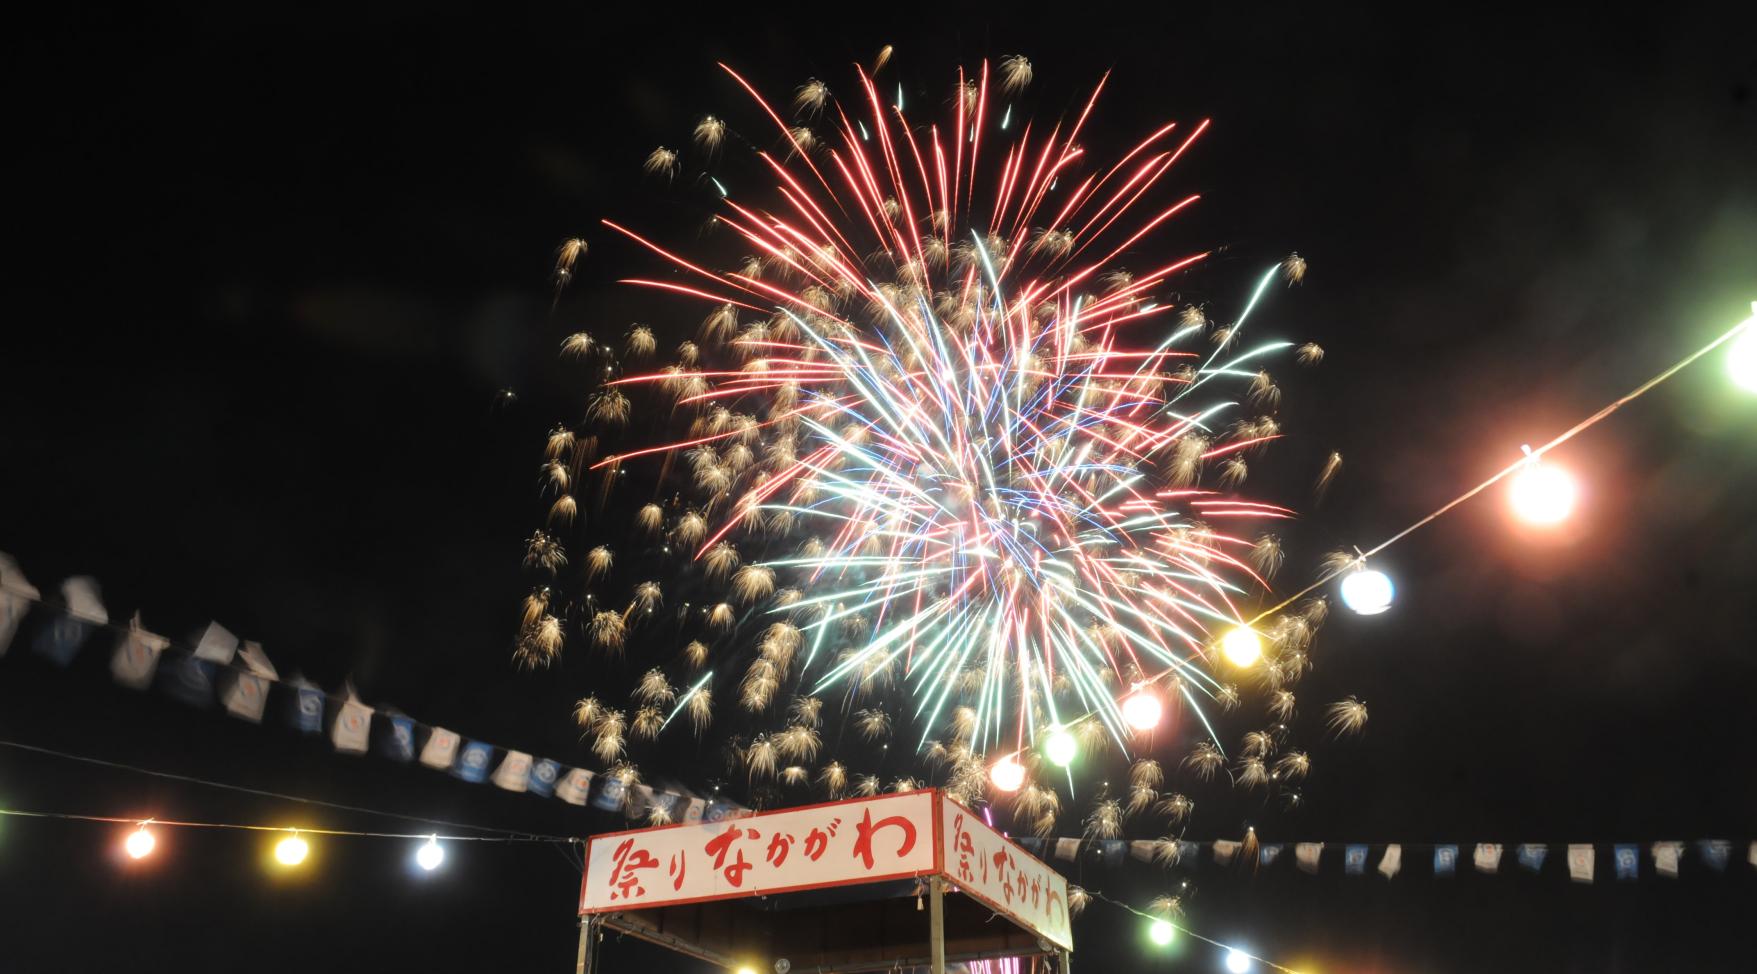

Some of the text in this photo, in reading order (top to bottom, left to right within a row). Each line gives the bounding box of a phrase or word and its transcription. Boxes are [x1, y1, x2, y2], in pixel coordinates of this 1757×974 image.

[610, 807, 917, 900] 祭りなかがわ
[954, 813, 1065, 929] 祭りなかがわ
